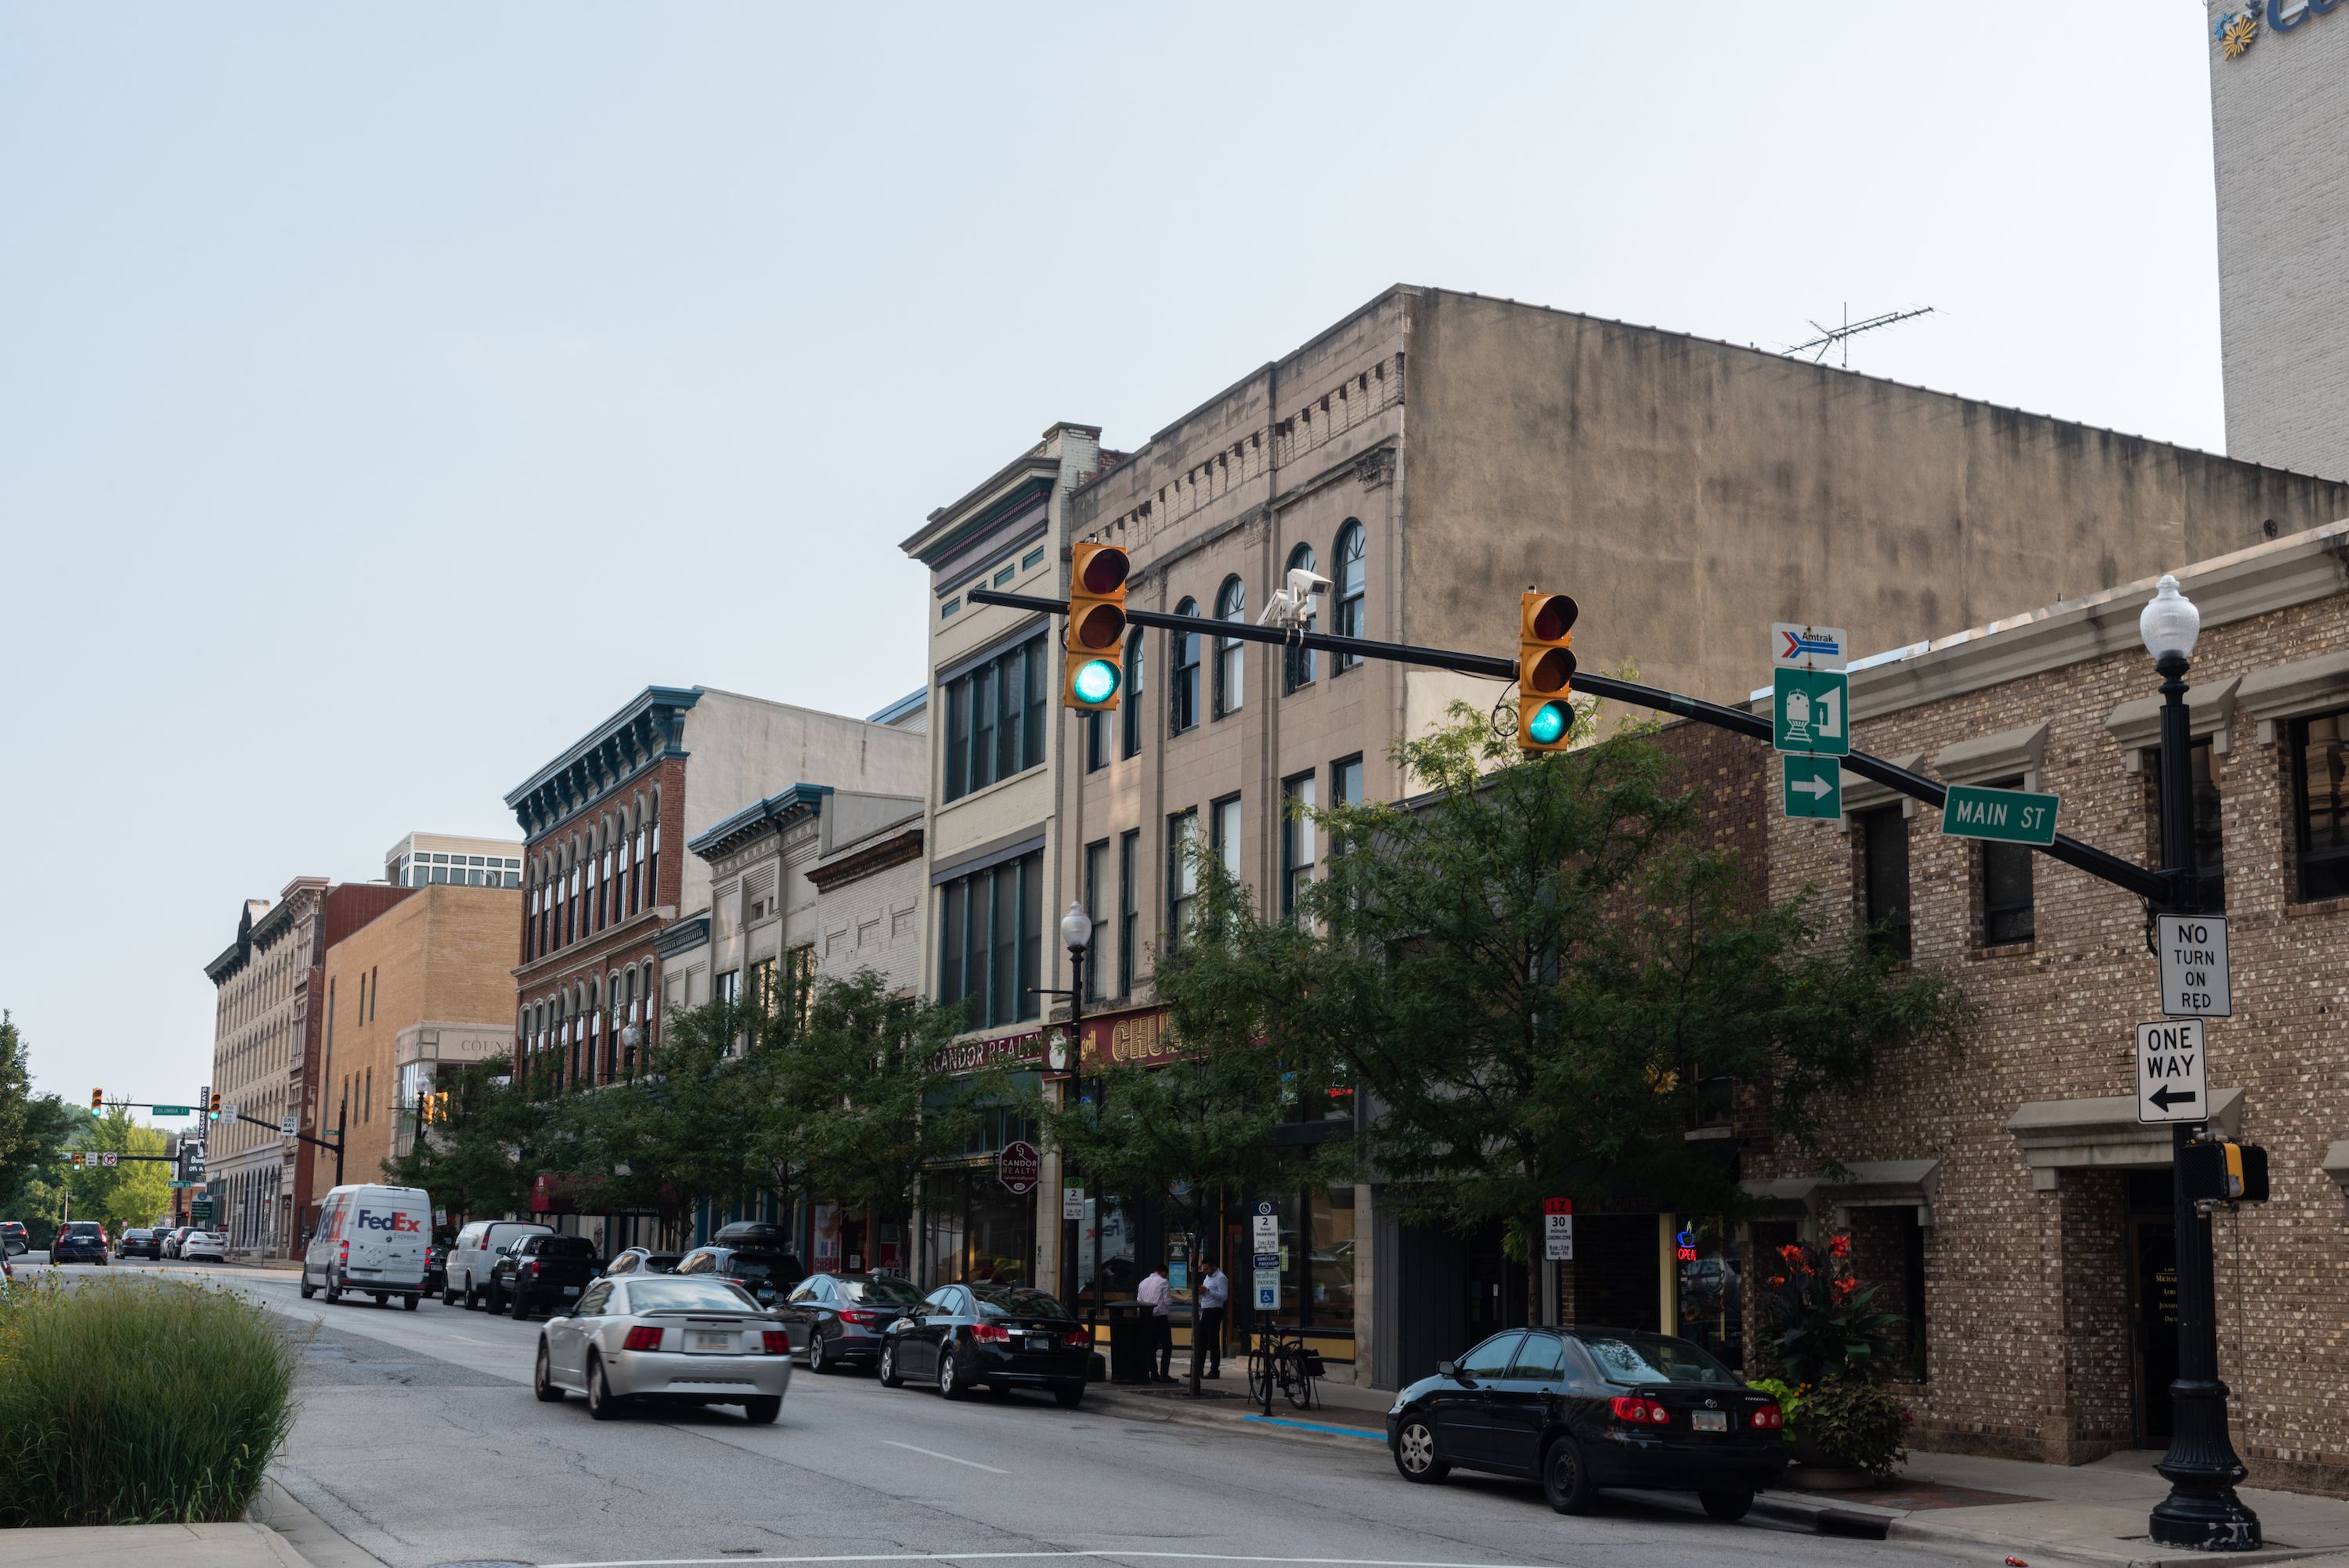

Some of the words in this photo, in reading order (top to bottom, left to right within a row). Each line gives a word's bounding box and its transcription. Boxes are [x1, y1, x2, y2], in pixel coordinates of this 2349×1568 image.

[1802, 632, 1833, 642] Amtrak
[1957, 800, 2008, 826] MAIN
[2021, 806, 2046, 830] ST
[2178, 925, 2207, 944] NO
[2174, 950, 2214, 965] TURN
[2185, 971, 2206, 986] ON
[2181, 993, 2211, 1008] RED
[1081, 1028, 1096, 1061] grill
[2148, 1027, 2192, 1051] ONE
[934, 1044, 984, 1072] CANDOR
[989, 1033, 1041, 1064] REALTY
[2148, 1054, 2195, 1079] WAY
[1551, 1201, 1567, 1212] LZ
[358, 1209, 420, 1232] FedEx
[1262, 1217, 1268, 1226] 2
[1552, 1217, 1566, 1227] 30
[1677, 1249, 1698, 1261] OPEN
